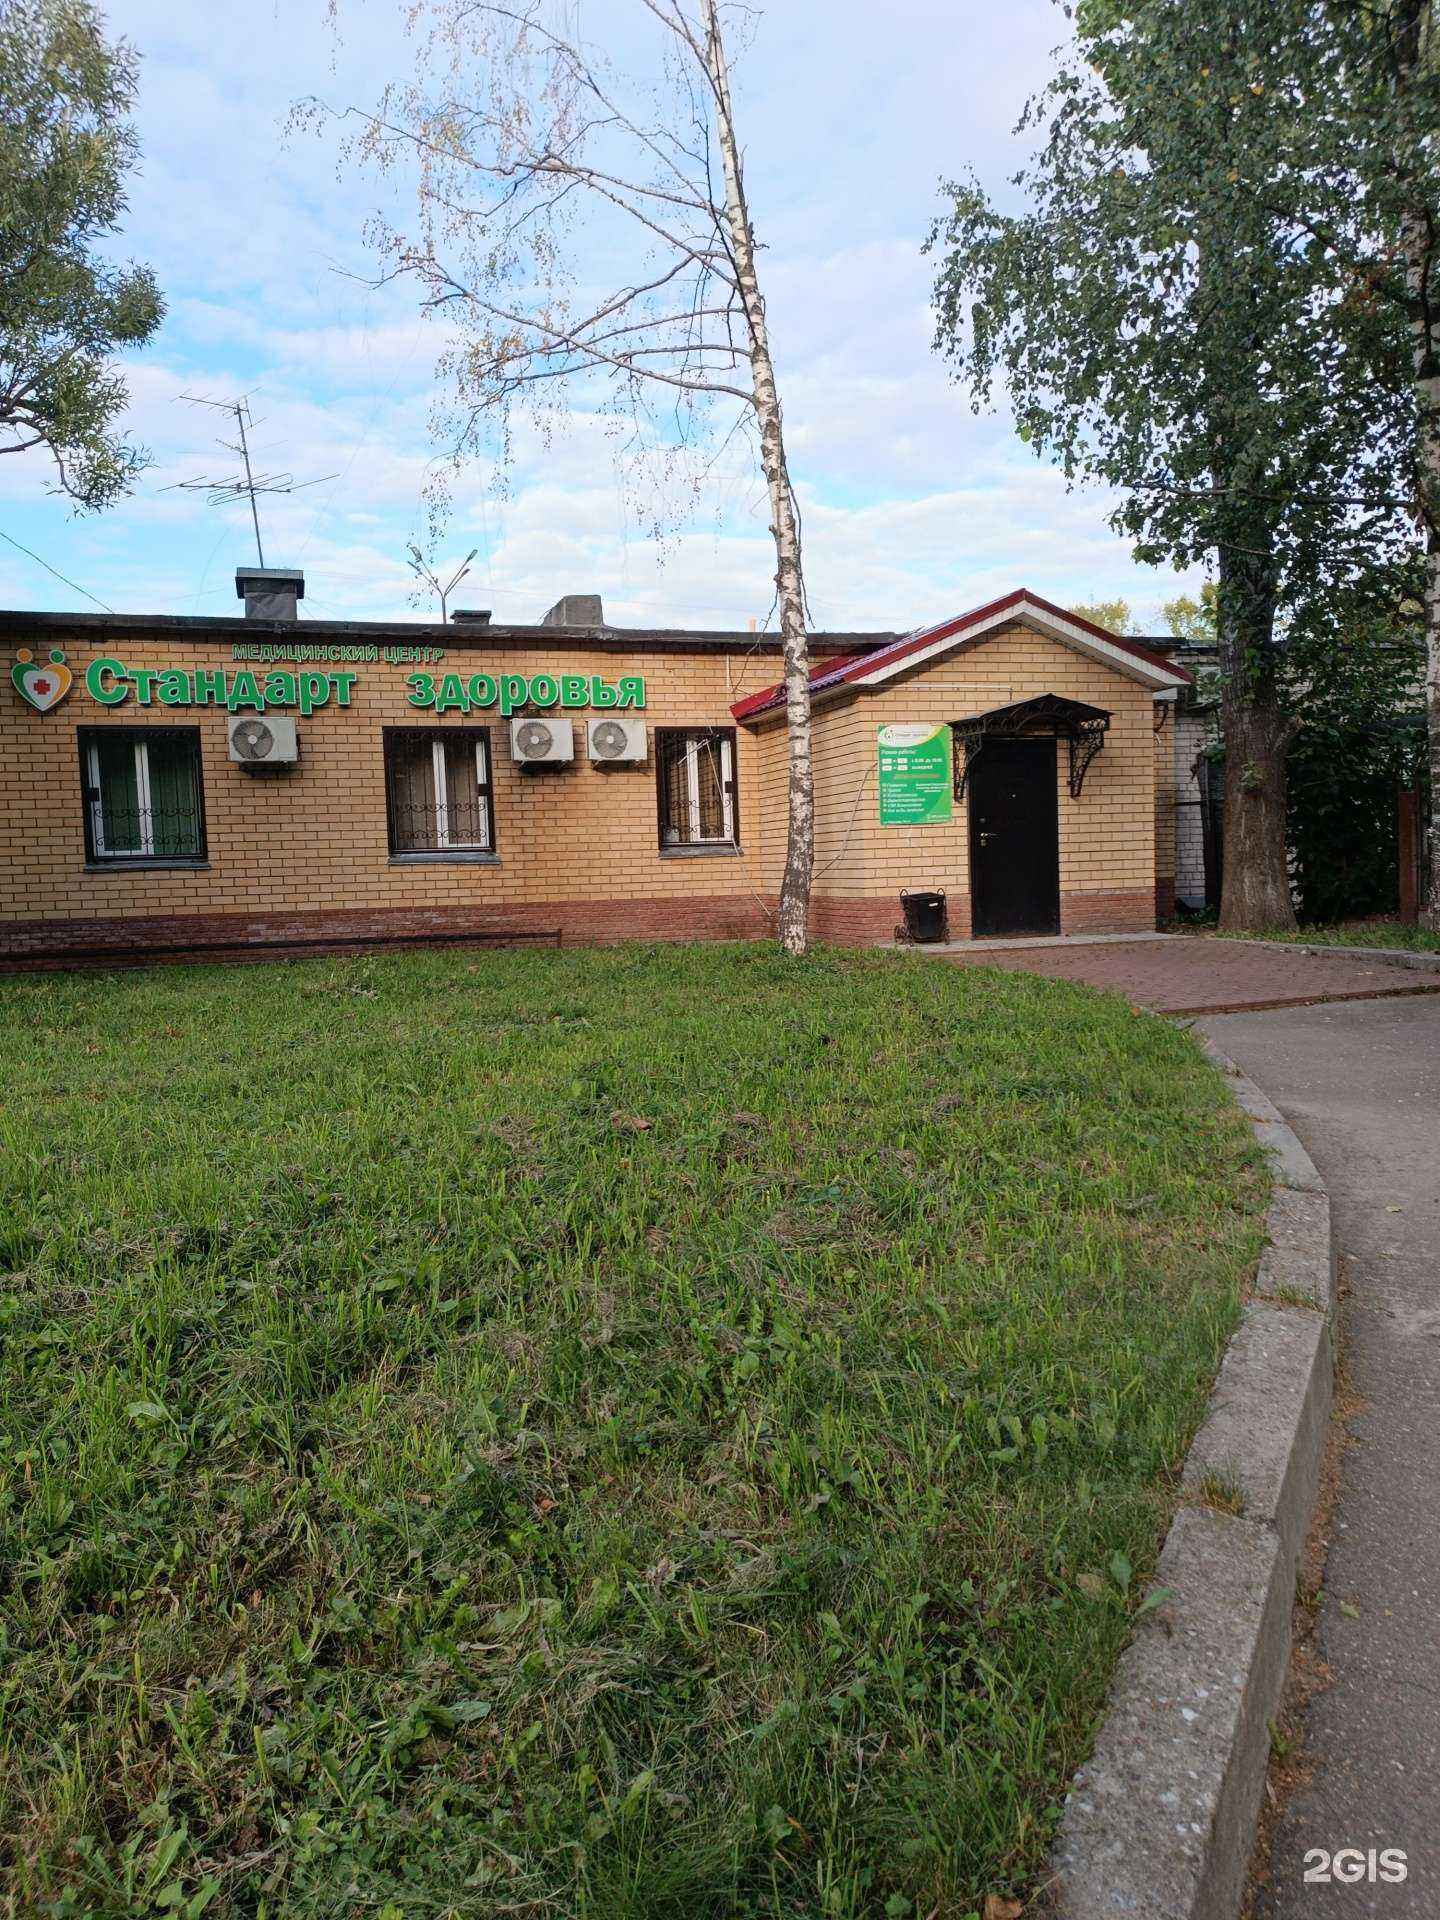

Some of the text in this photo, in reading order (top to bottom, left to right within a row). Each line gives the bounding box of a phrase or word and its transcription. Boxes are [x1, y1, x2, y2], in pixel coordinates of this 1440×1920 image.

[231, 644, 445, 665] МЕДИЦИНСКИЙ ЦЕНТР
[86, 657, 646, 716] Стандарт здоровья
